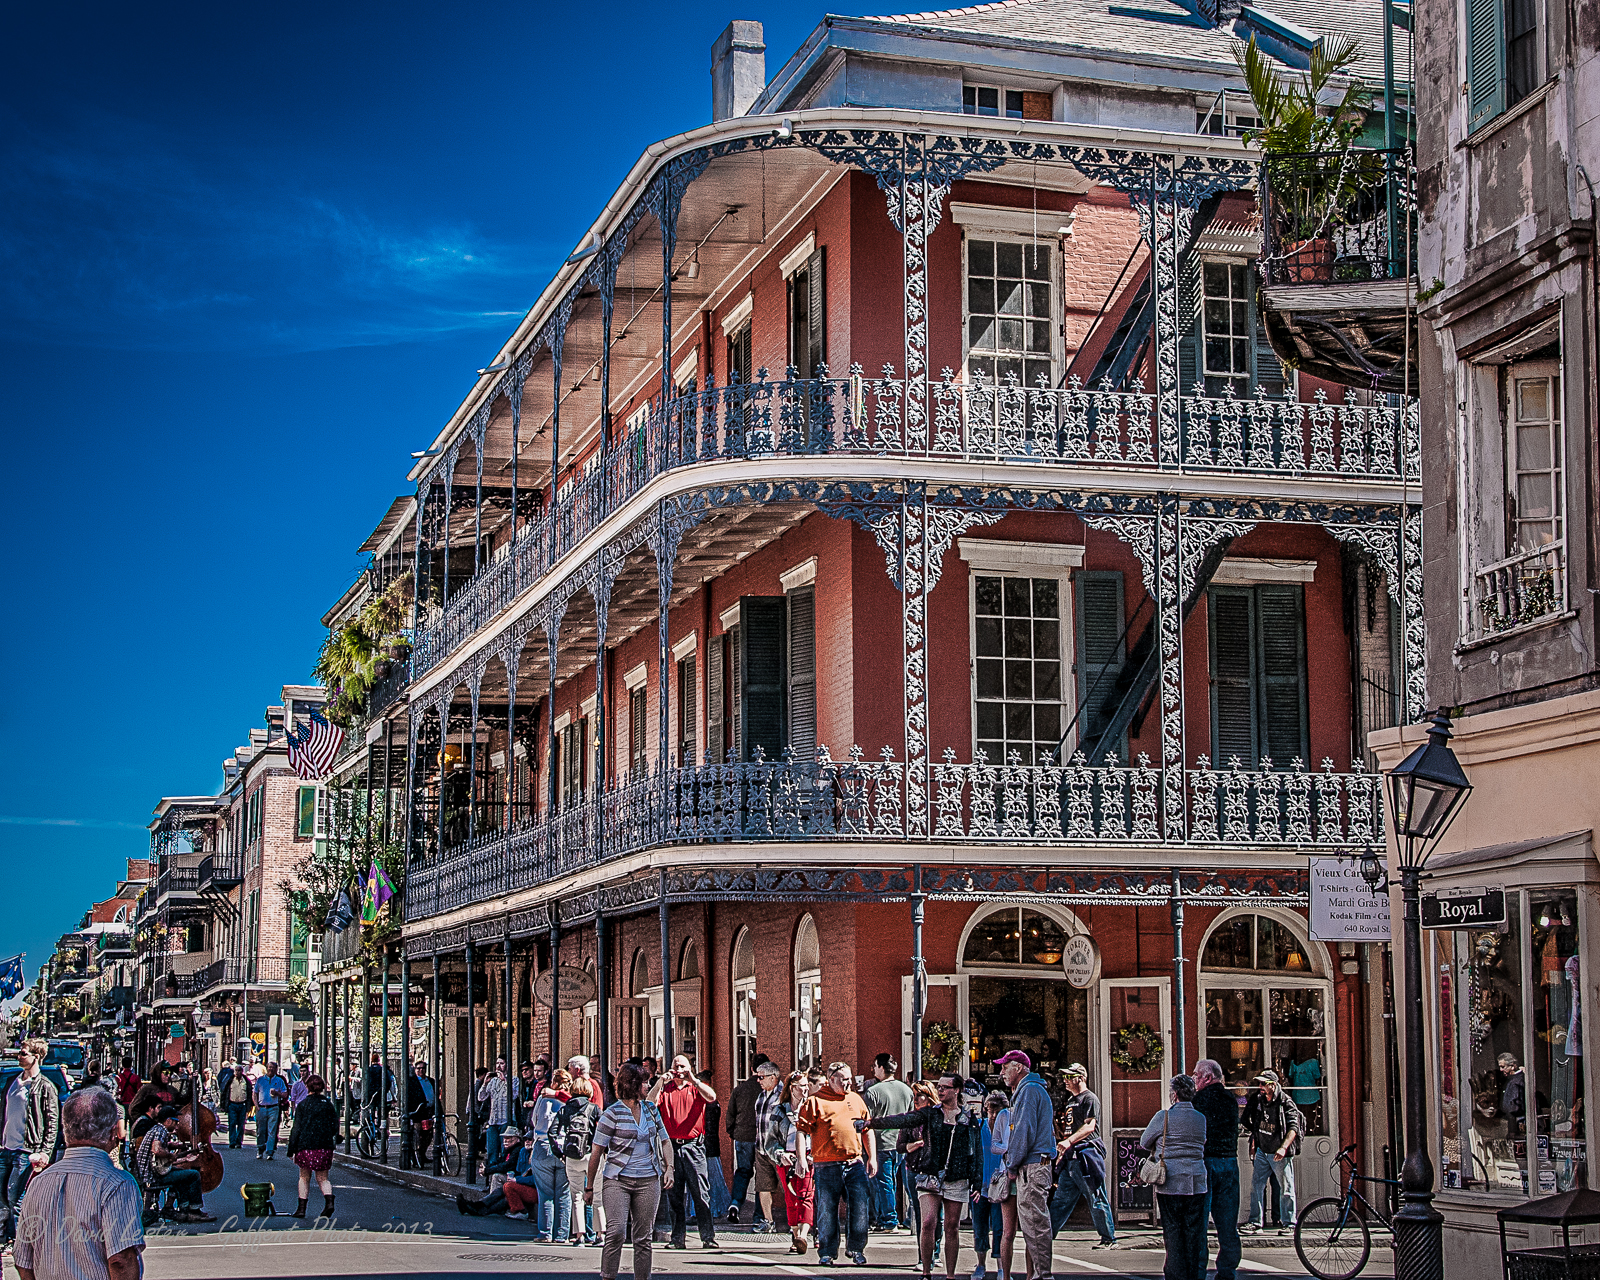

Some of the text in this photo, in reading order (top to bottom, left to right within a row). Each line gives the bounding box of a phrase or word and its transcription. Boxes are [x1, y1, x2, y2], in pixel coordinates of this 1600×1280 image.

[1315, 868, 1341, 878] Vieux
[1319, 884, 1348, 892] T-Shirts
[1328, 897, 1355, 907] Mardi
[1357, 897, 1379, 907] Gras
[1438, 897, 1484, 923] Royal
[1329, 912, 1353, 920] Kodak
[1355, 912, 1371, 920] Film
[1344, 925, 1391, 934] 640 Royal St.
[1067, 940, 1091, 959] FOREVER
